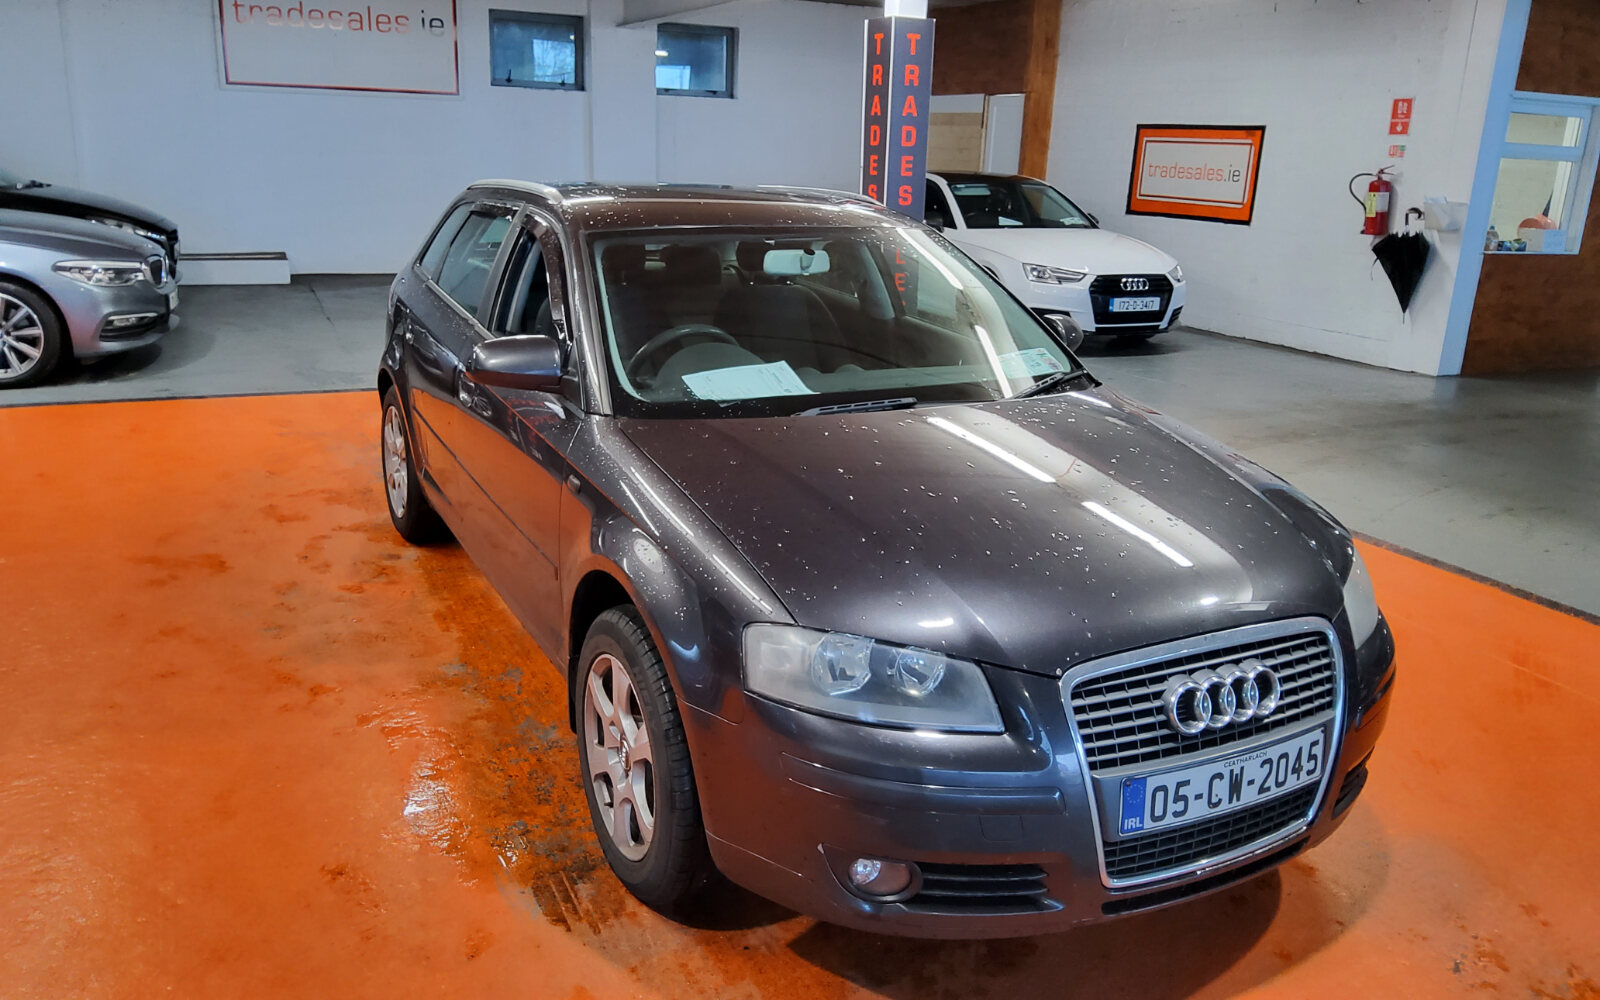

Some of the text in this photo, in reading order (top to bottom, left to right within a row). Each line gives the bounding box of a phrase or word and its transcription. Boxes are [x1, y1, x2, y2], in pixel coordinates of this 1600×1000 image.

[1148, 161, 1241, 183] tradesales.ie
[1150, 739, 1320, 824] 05-CW-2045
[1123, 817, 1143, 831] IRL
